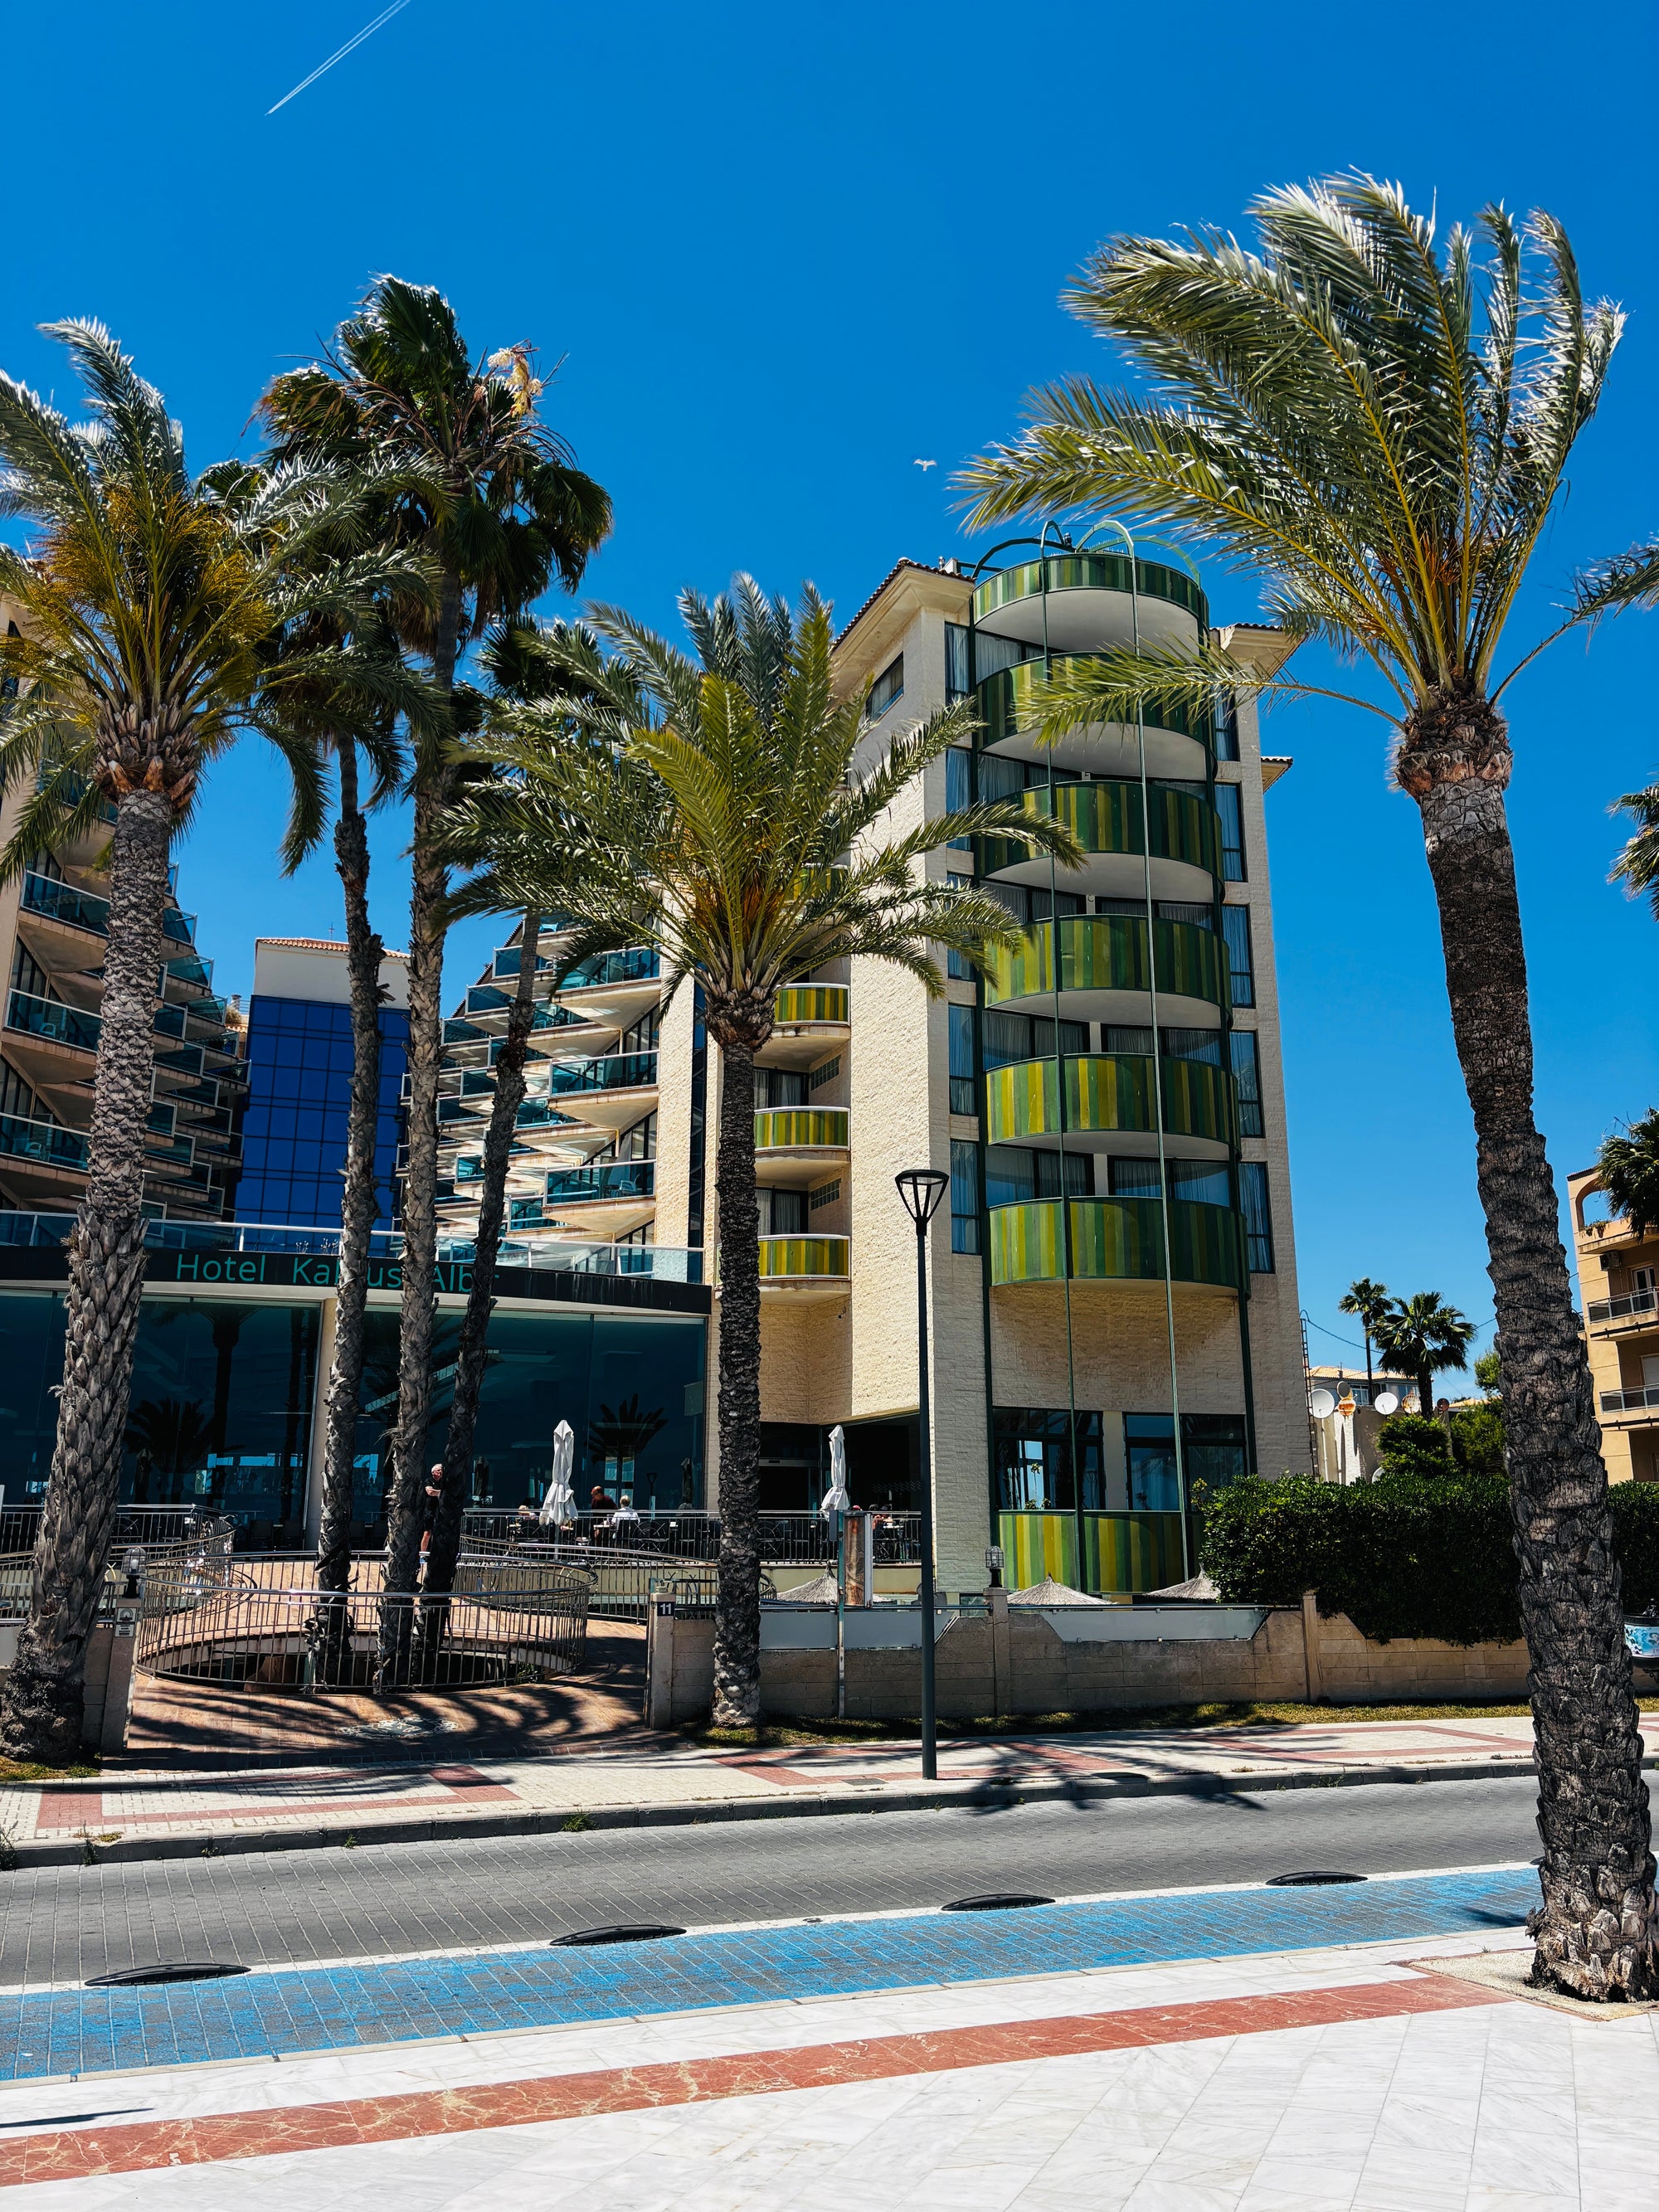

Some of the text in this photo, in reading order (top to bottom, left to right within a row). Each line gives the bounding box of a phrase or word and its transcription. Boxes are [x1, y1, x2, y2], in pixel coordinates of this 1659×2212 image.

[177, 1254, 499, 1292] Hotel Kaus Alb
[659, 1602, 672, 1615] 11
